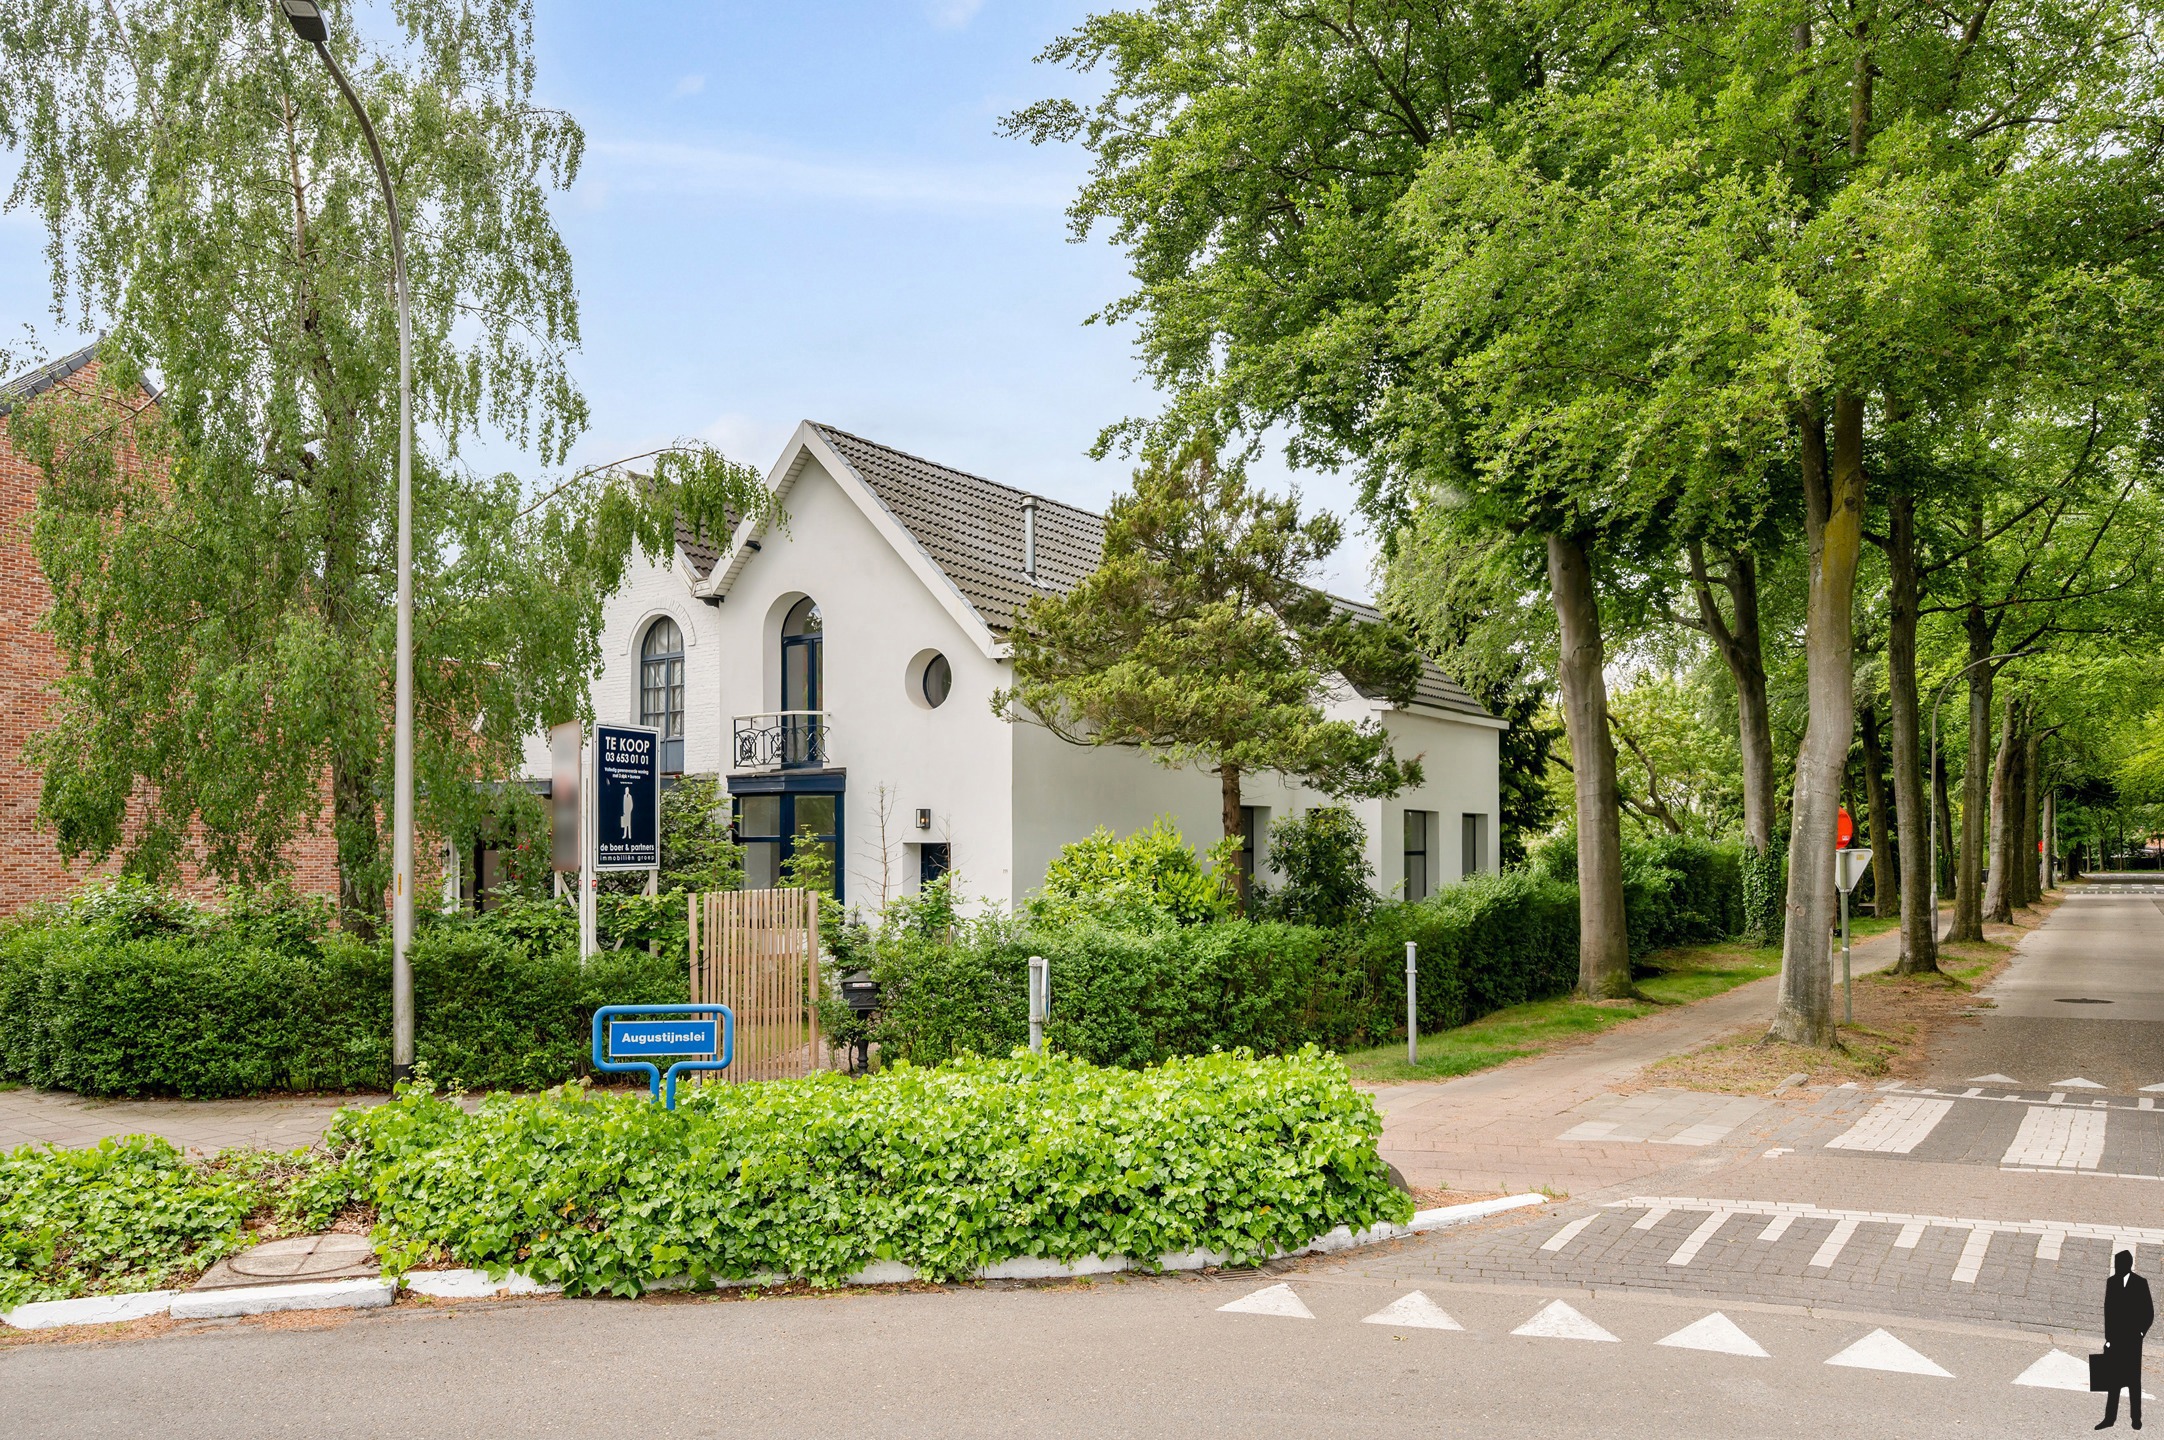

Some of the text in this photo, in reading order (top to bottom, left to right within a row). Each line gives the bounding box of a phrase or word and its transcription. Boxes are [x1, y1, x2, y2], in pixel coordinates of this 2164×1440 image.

[605, 736, 650, 753] TE KOOP
[605, 752, 649, 765] 03 653 01 01
[600, 843, 654, 852] de boer & partners
[621, 1032, 705, 1044] Augustijnslei
